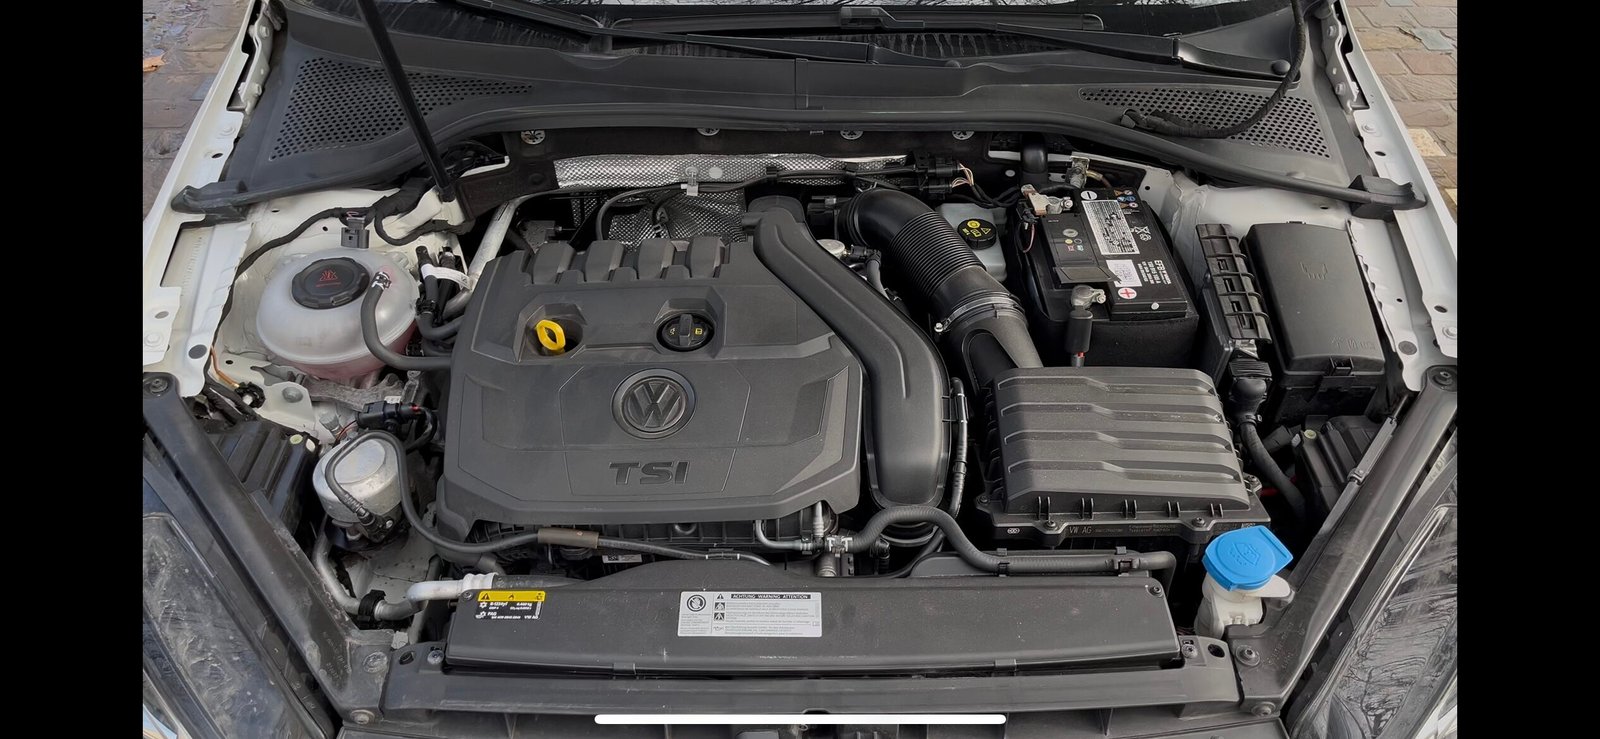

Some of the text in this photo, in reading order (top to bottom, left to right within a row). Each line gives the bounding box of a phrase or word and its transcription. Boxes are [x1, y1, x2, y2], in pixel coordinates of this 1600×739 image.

[622, 376, 686, 433] VW
[609, 461, 691, 485] TSI
[1069, 526, 1080, 534] VW
[1082, 526, 1092, 534] AG
